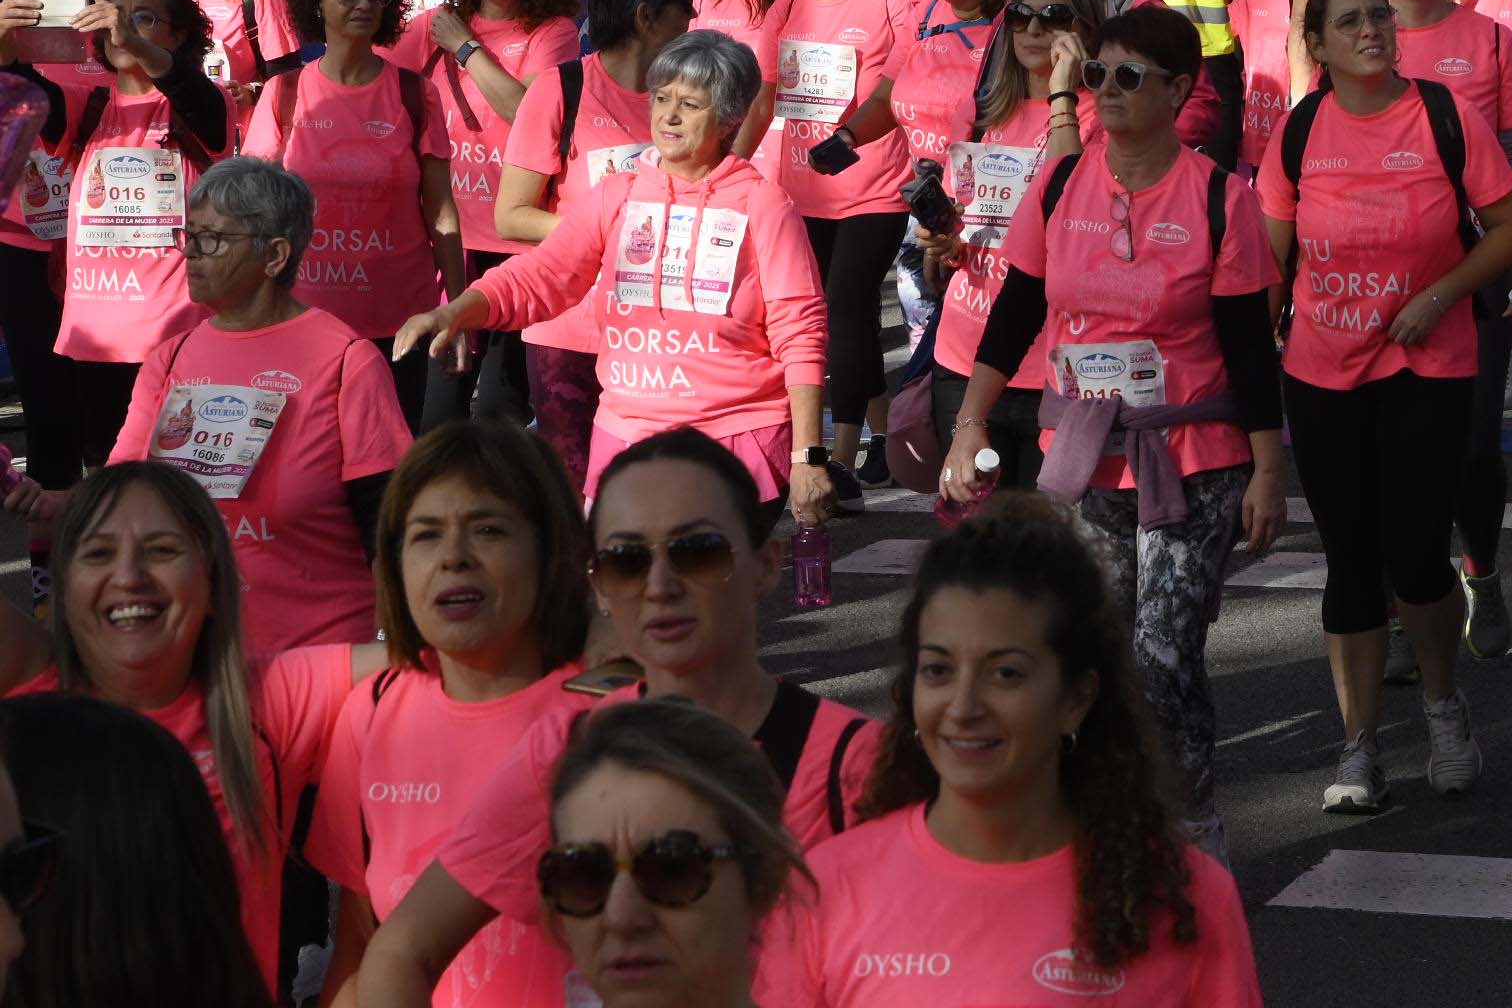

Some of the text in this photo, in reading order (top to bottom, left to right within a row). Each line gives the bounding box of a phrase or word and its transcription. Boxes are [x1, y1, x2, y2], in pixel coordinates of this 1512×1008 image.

[802, 73, 828, 85] 016
[804, 87, 824, 95] 14283
[780, 105, 806, 113] OYSHO
[893, 101, 915, 121] TU
[789, 122, 833, 140] DORS
[791, 146, 809, 165] SU
[108, 166, 147, 174] ASTURIANA
[980, 160, 1019, 174] ASTURIANA
[1306, 158, 1348, 170] OYSHO
[109, 187, 146, 201] 016
[977, 184, 1011, 200] 016
[114, 205, 141, 214] 16085
[980, 203, 1003, 213] 23523
[1064, 219, 1110, 233] OYSHO
[310, 229, 394, 252] ORSAL
[1303, 239, 1331, 262] TU
[72, 267, 142, 292] SUMA
[1311, 272, 1411, 297] DORSAL
[1311, 302, 1383, 332] SUMA
[606, 326, 720, 354] DORSAL
[1129, 355, 1155, 364] SUMA
[609, 360, 691, 389] SUMA
[1079, 362, 1123, 374] ASTURIANA
[255, 379, 298, 390] ASTURIANA
[202, 405, 245, 417] ASTURIANA
[194, 431, 234, 448] 016
[192, 448, 226, 463] 16086
[368, 782, 441, 803] OYSHO
[855, 952, 951, 977] OYSHO
